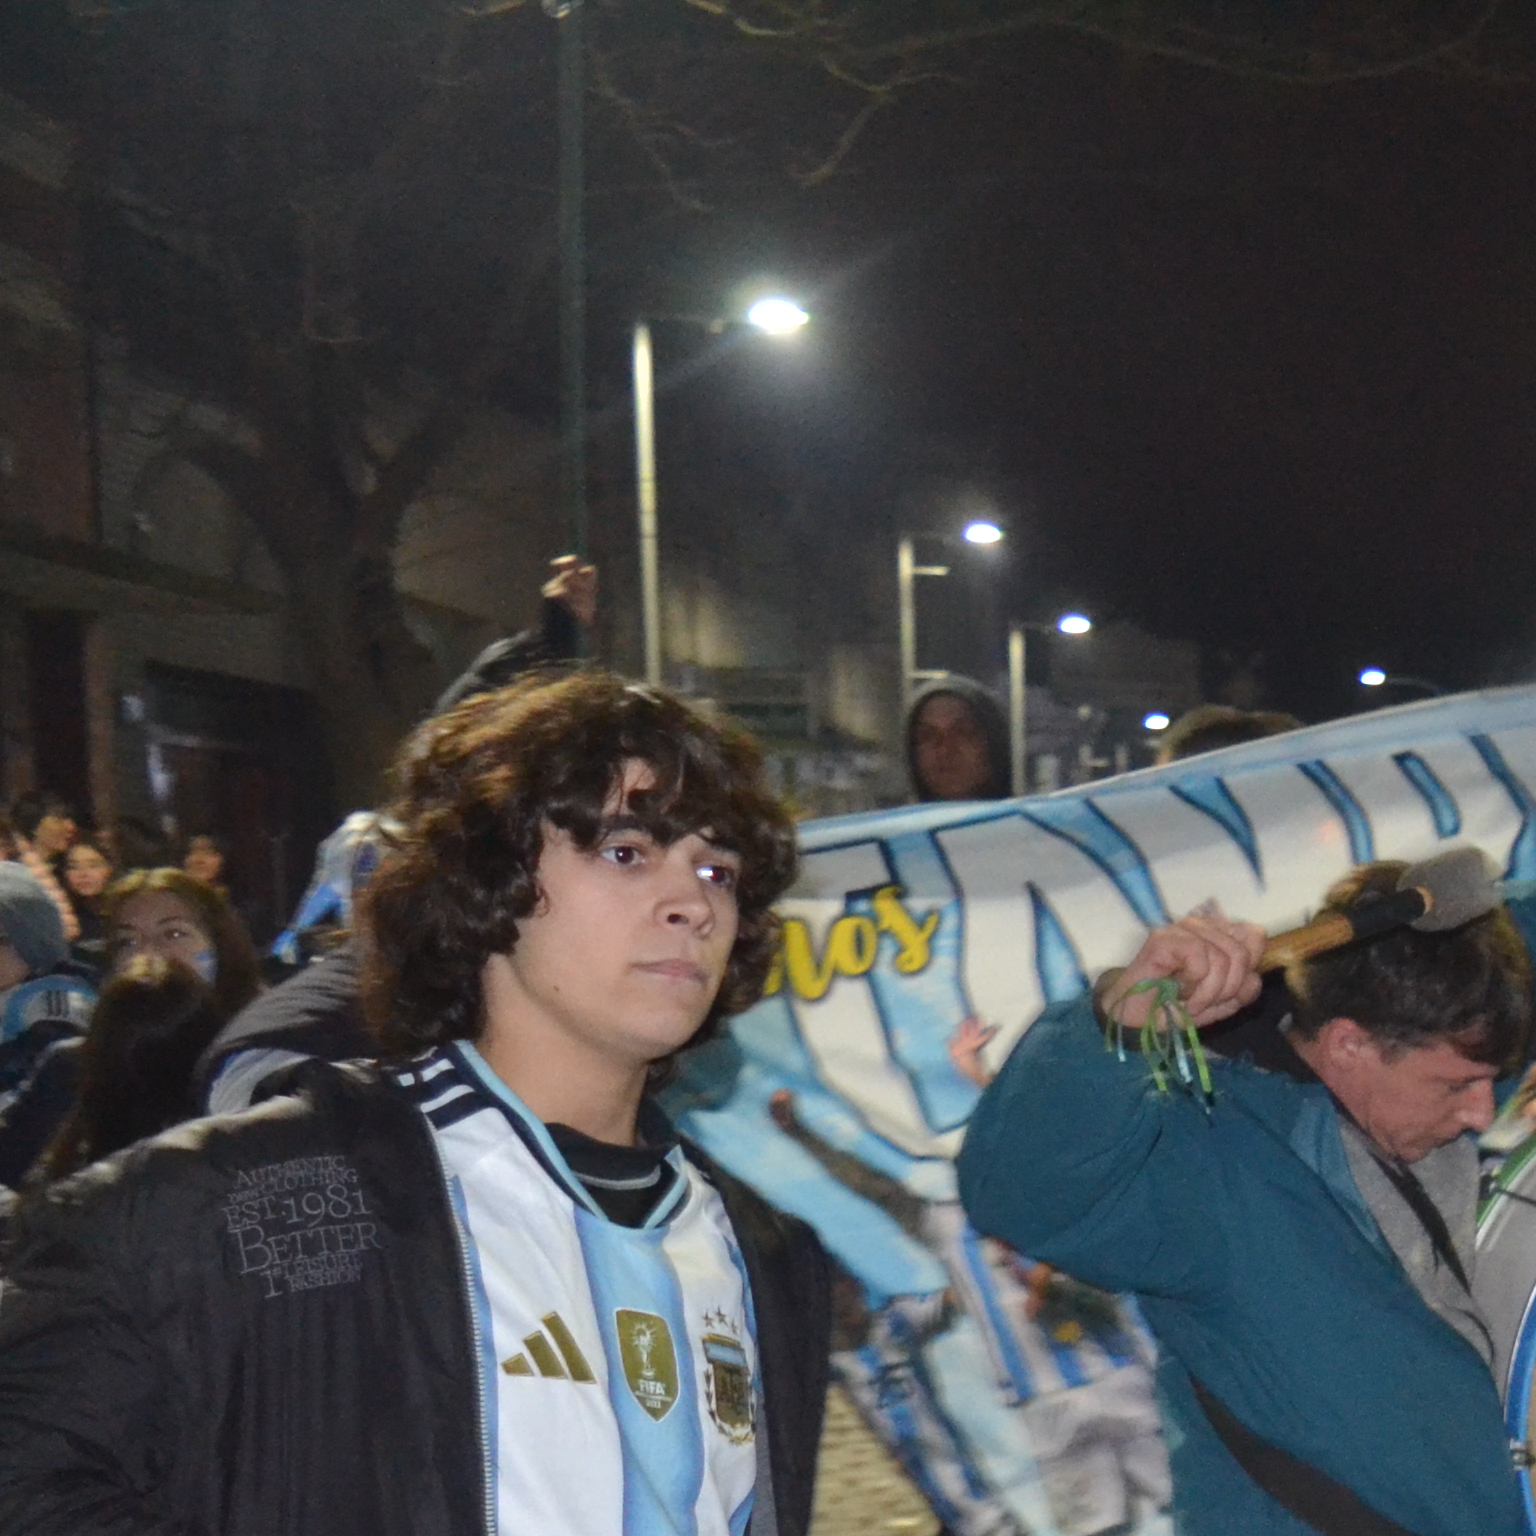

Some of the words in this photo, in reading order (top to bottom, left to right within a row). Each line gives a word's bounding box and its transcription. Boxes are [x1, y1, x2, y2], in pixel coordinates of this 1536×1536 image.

[236, 1155, 347, 1187] AUTHENTIC
[260, 1168, 358, 1196] CLOTHING
[638, 1379, 665, 1395] FIFA
